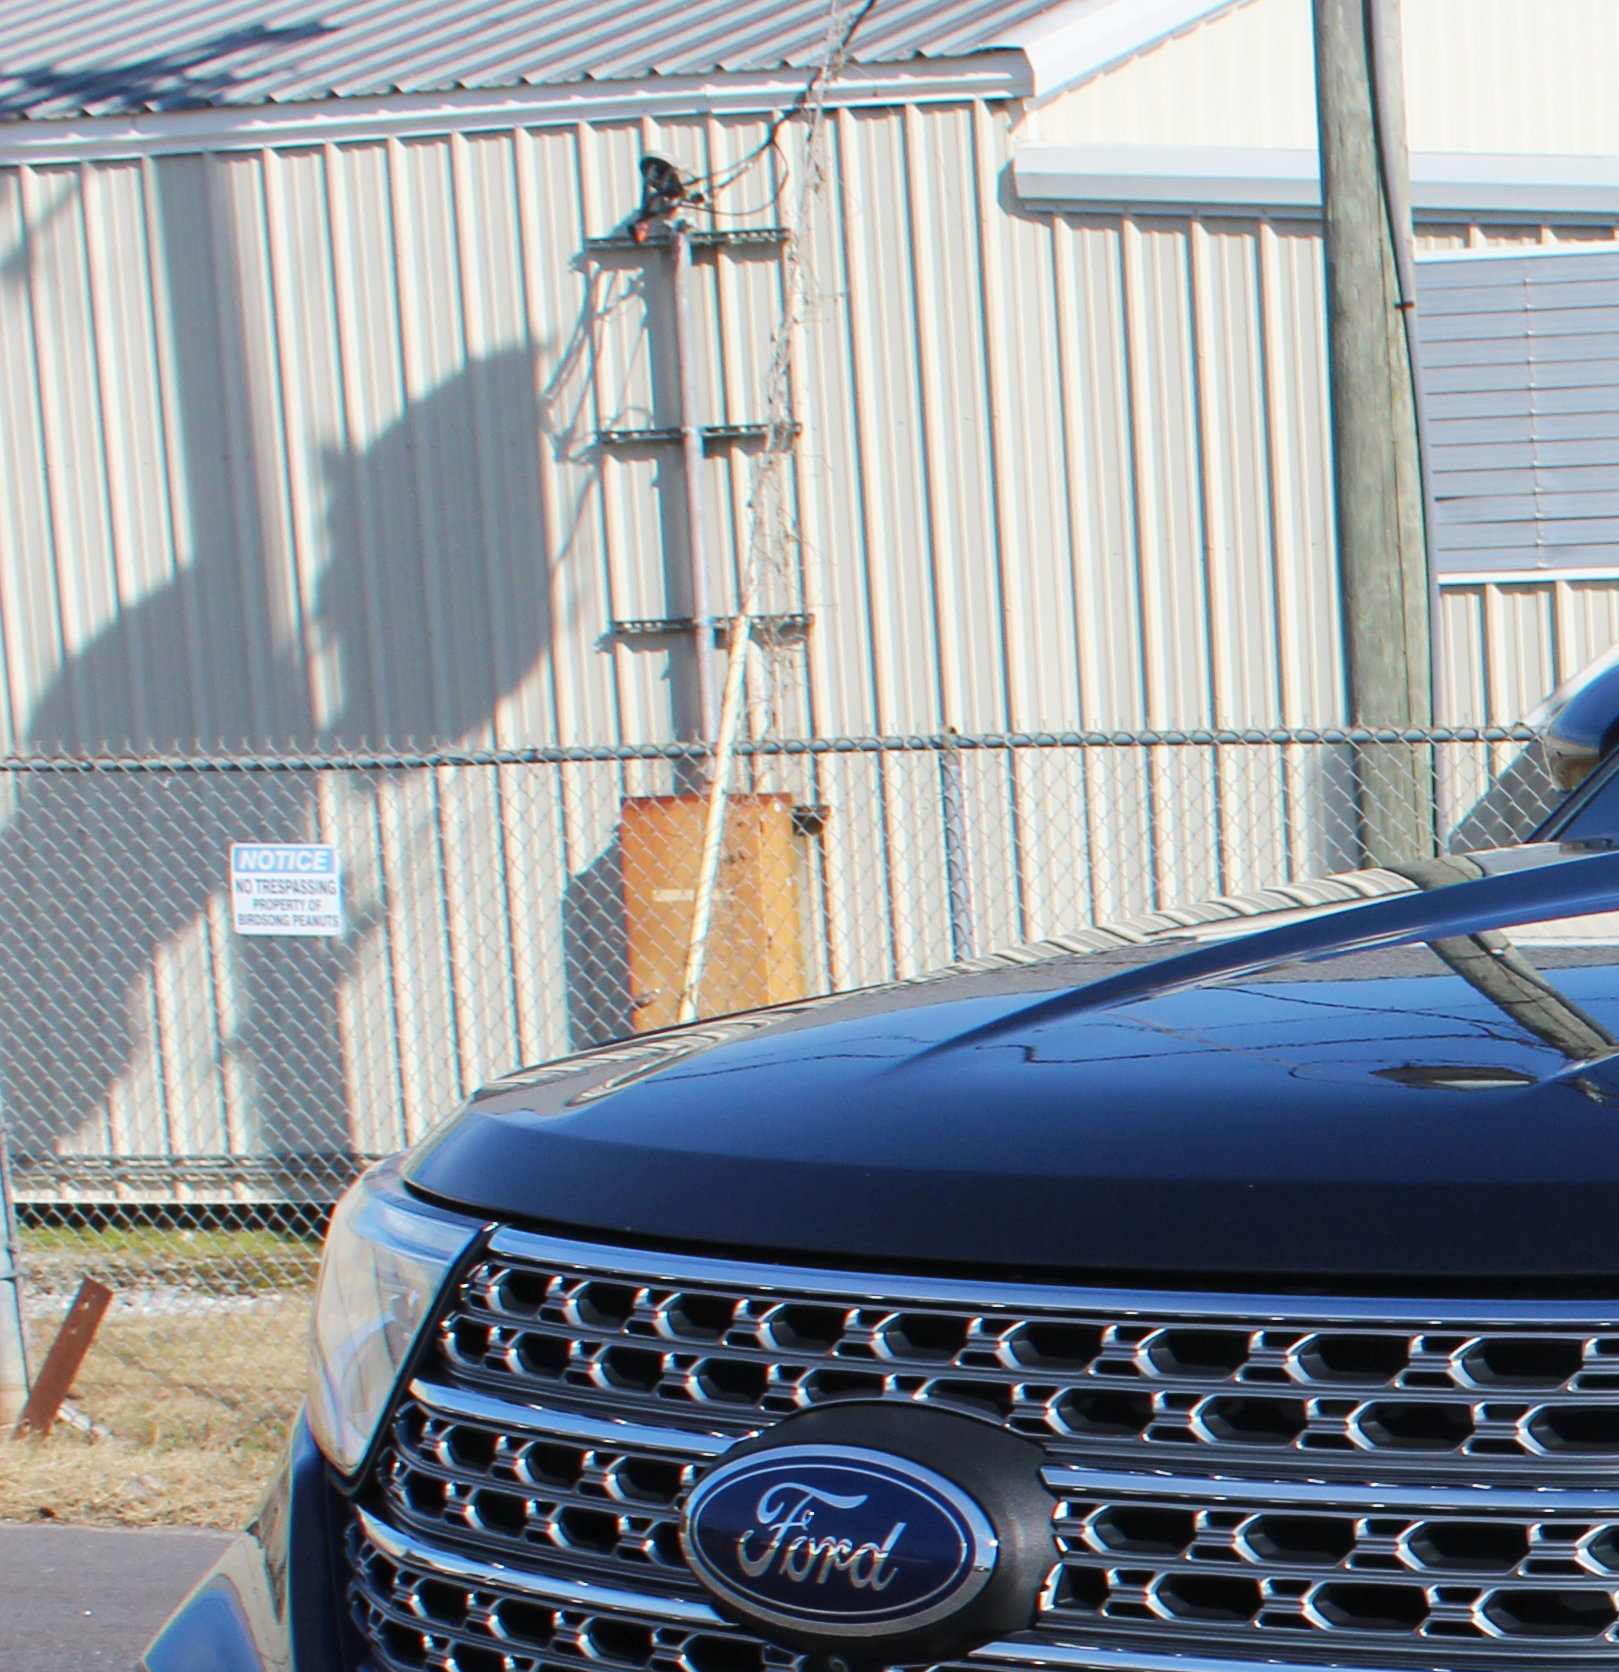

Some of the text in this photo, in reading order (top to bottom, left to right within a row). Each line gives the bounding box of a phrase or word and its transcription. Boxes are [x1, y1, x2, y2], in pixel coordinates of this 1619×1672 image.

[238, 850, 328, 871] NOTICE
[235, 879, 337, 896] NO TRESPASSING
[252, 898, 322, 911] PROPERTY OF
[237, 914, 340, 928] BIRDSONG PEANUTS
[736, 1480, 908, 1592] Ford
